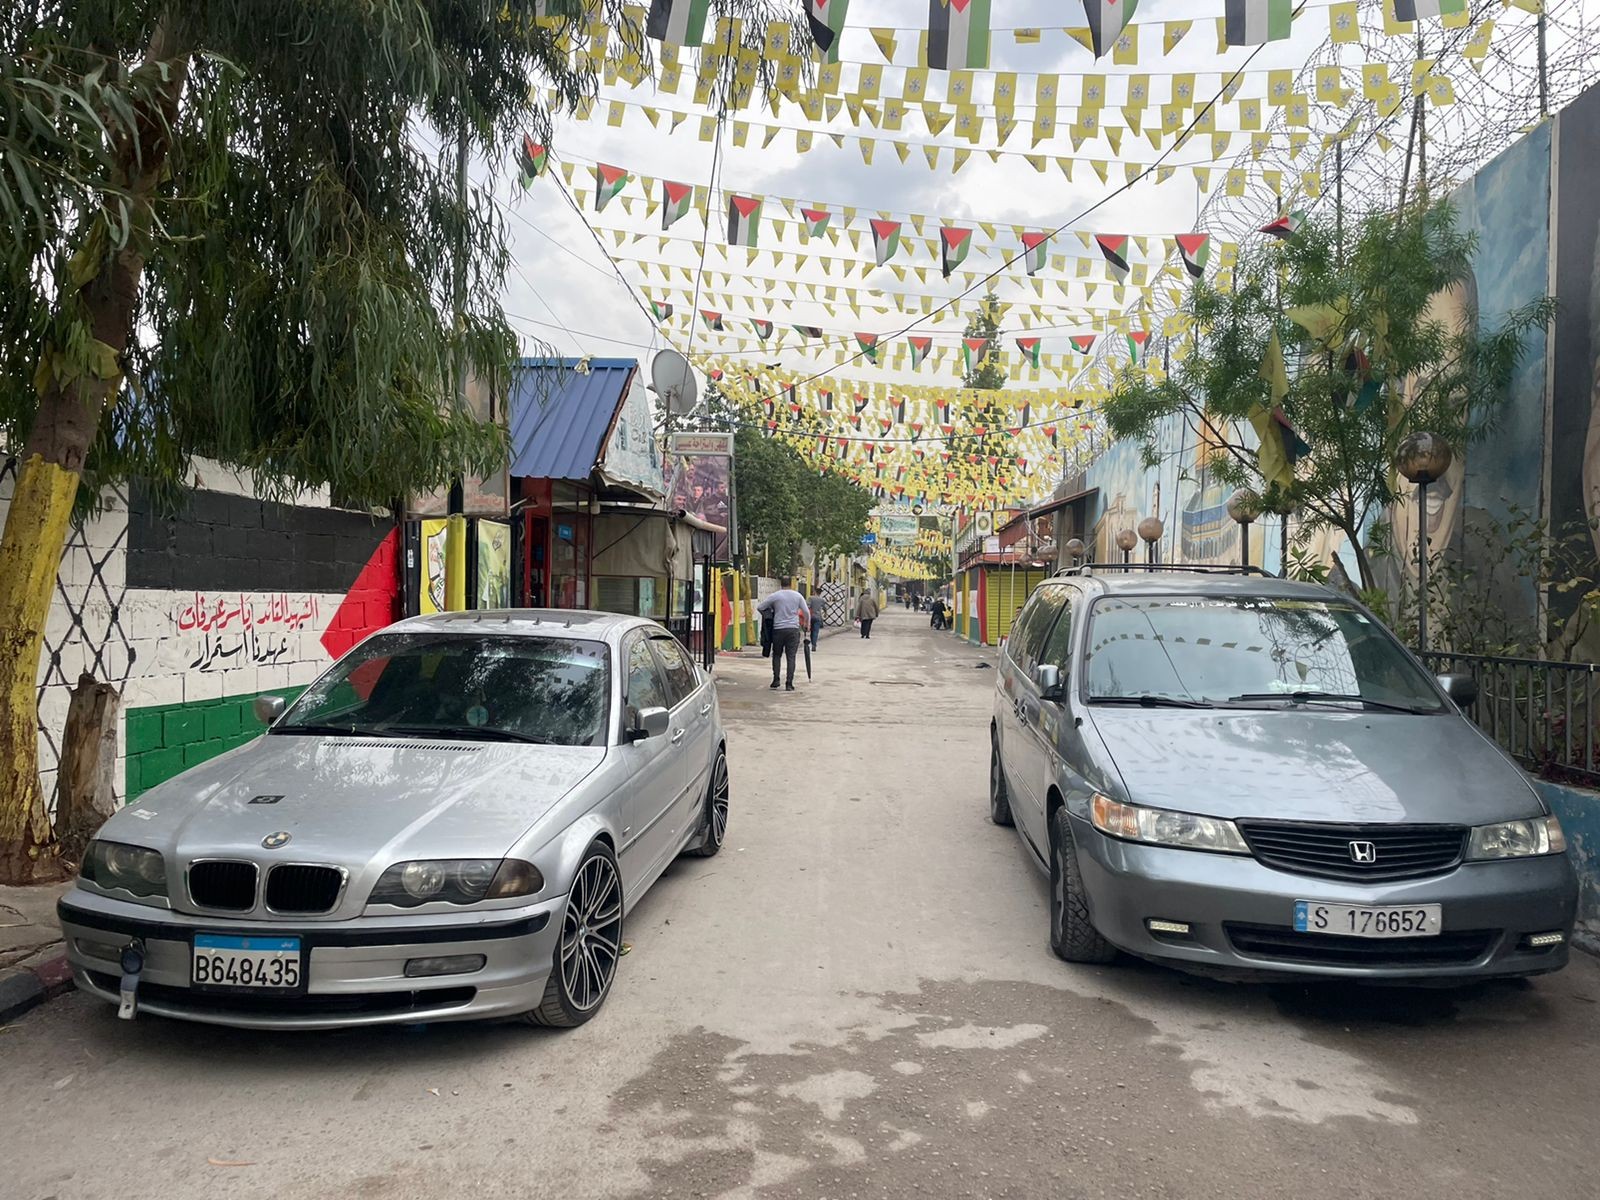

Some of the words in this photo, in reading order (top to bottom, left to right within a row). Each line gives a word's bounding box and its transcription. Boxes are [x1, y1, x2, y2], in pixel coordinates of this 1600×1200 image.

[179, 591, 225, 631] عرفات
[217, 593, 252, 630] ياسر
[257, 593, 289, 624] القائد
[285, 594, 319, 630] الشهيد
[190, 629, 248, 673] استمرار
[252, 626, 288, 664] عهدنا
[1314, 907, 1329, 929] S
[1348, 909, 1427, 933] 176652
[195, 955, 299, 986] B648435
